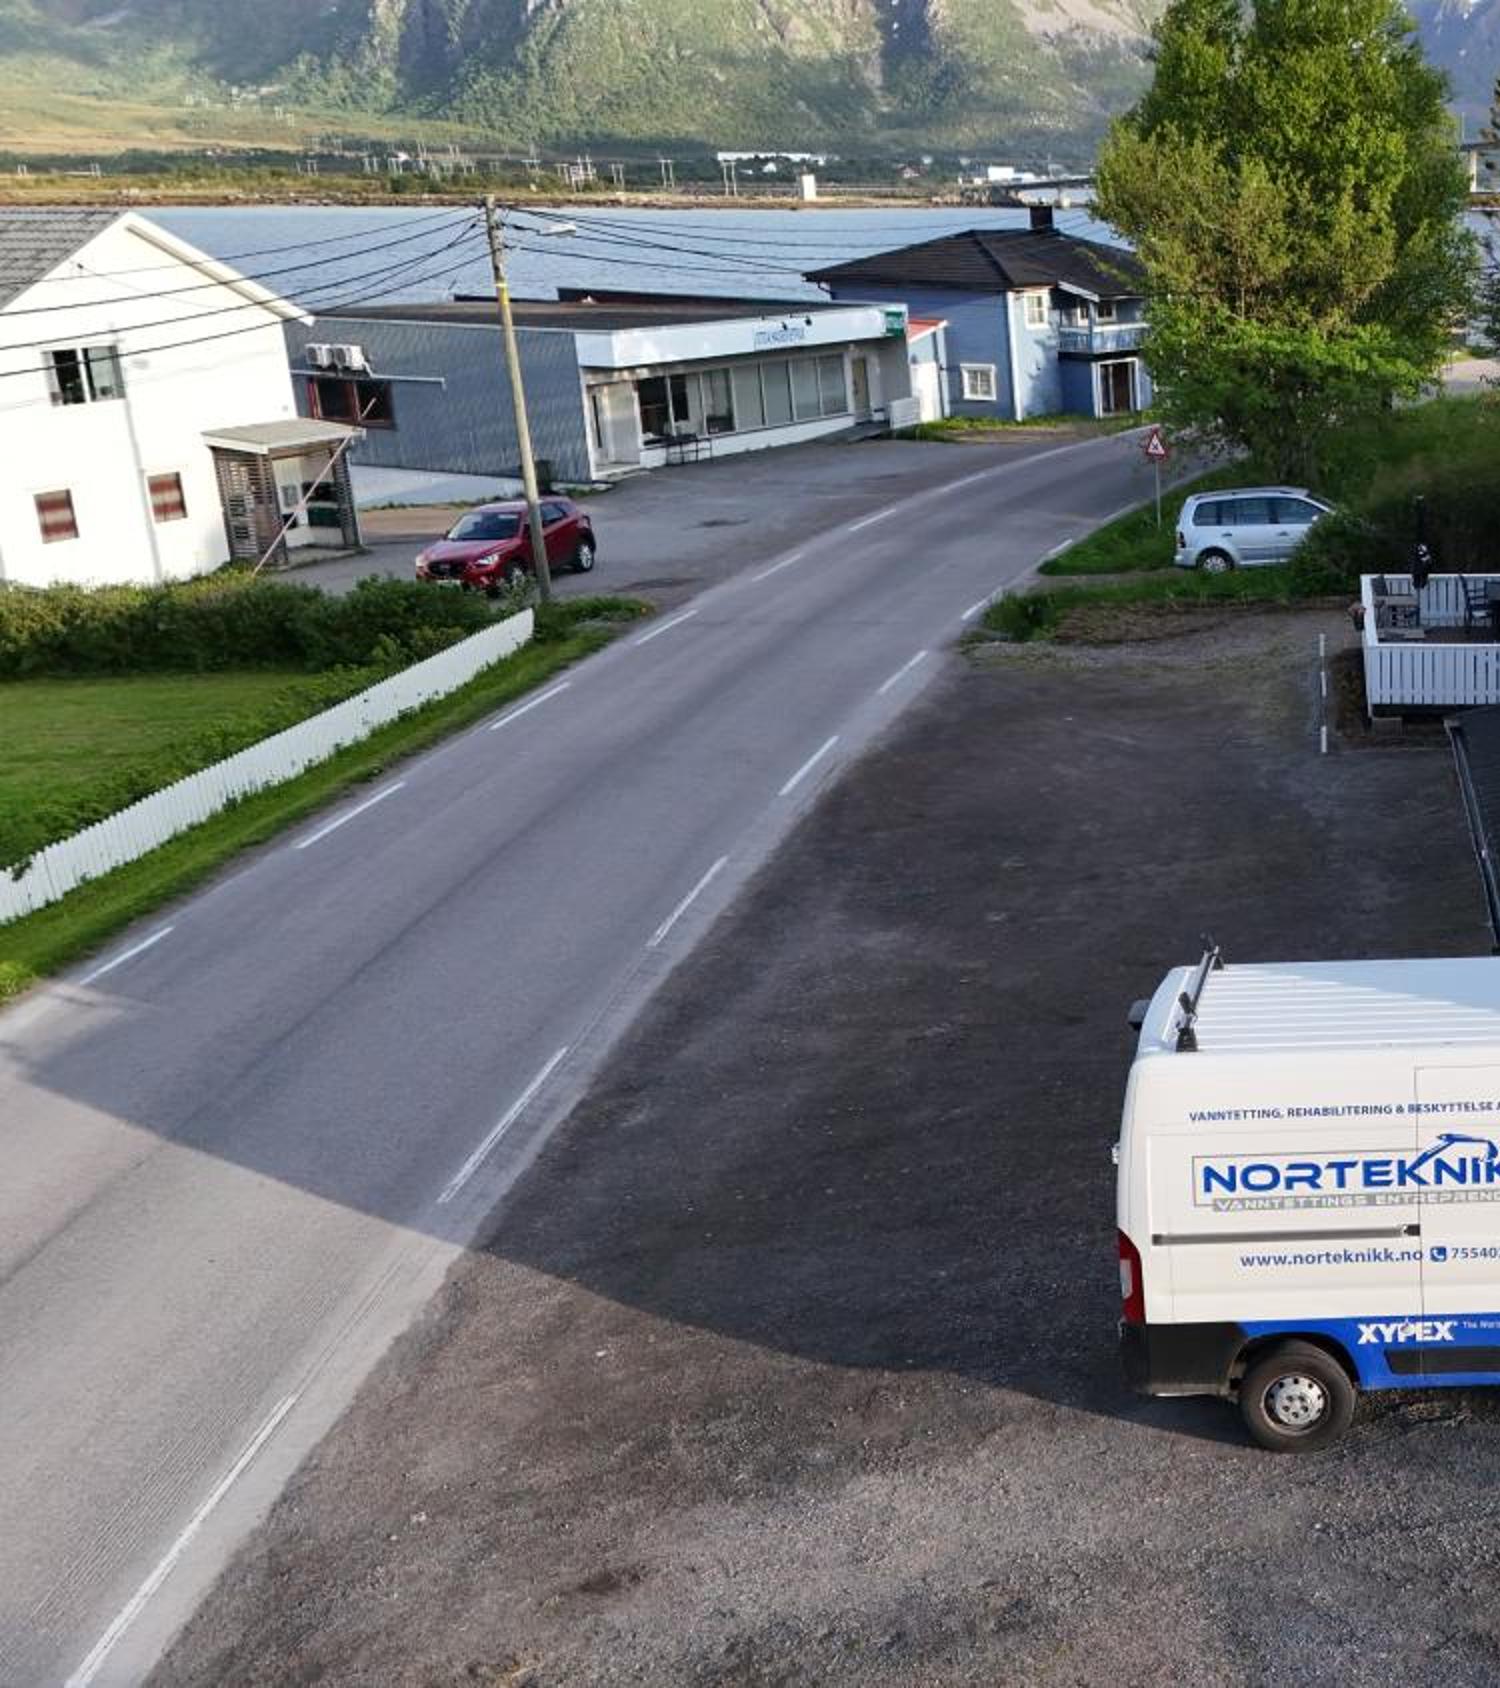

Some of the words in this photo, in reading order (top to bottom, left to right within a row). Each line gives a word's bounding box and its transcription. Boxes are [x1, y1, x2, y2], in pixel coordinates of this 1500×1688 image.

[1190, 1108, 1284, 1121] VANNTETTING,
[1287, 1104, 1393, 1117] REHABILITERING
[1396, 1103, 1405, 1114] &
[1408, 1100, 1493, 1113] BESKYTTELSE
[1240, 1248, 1423, 1267] www.norteknikk.no
